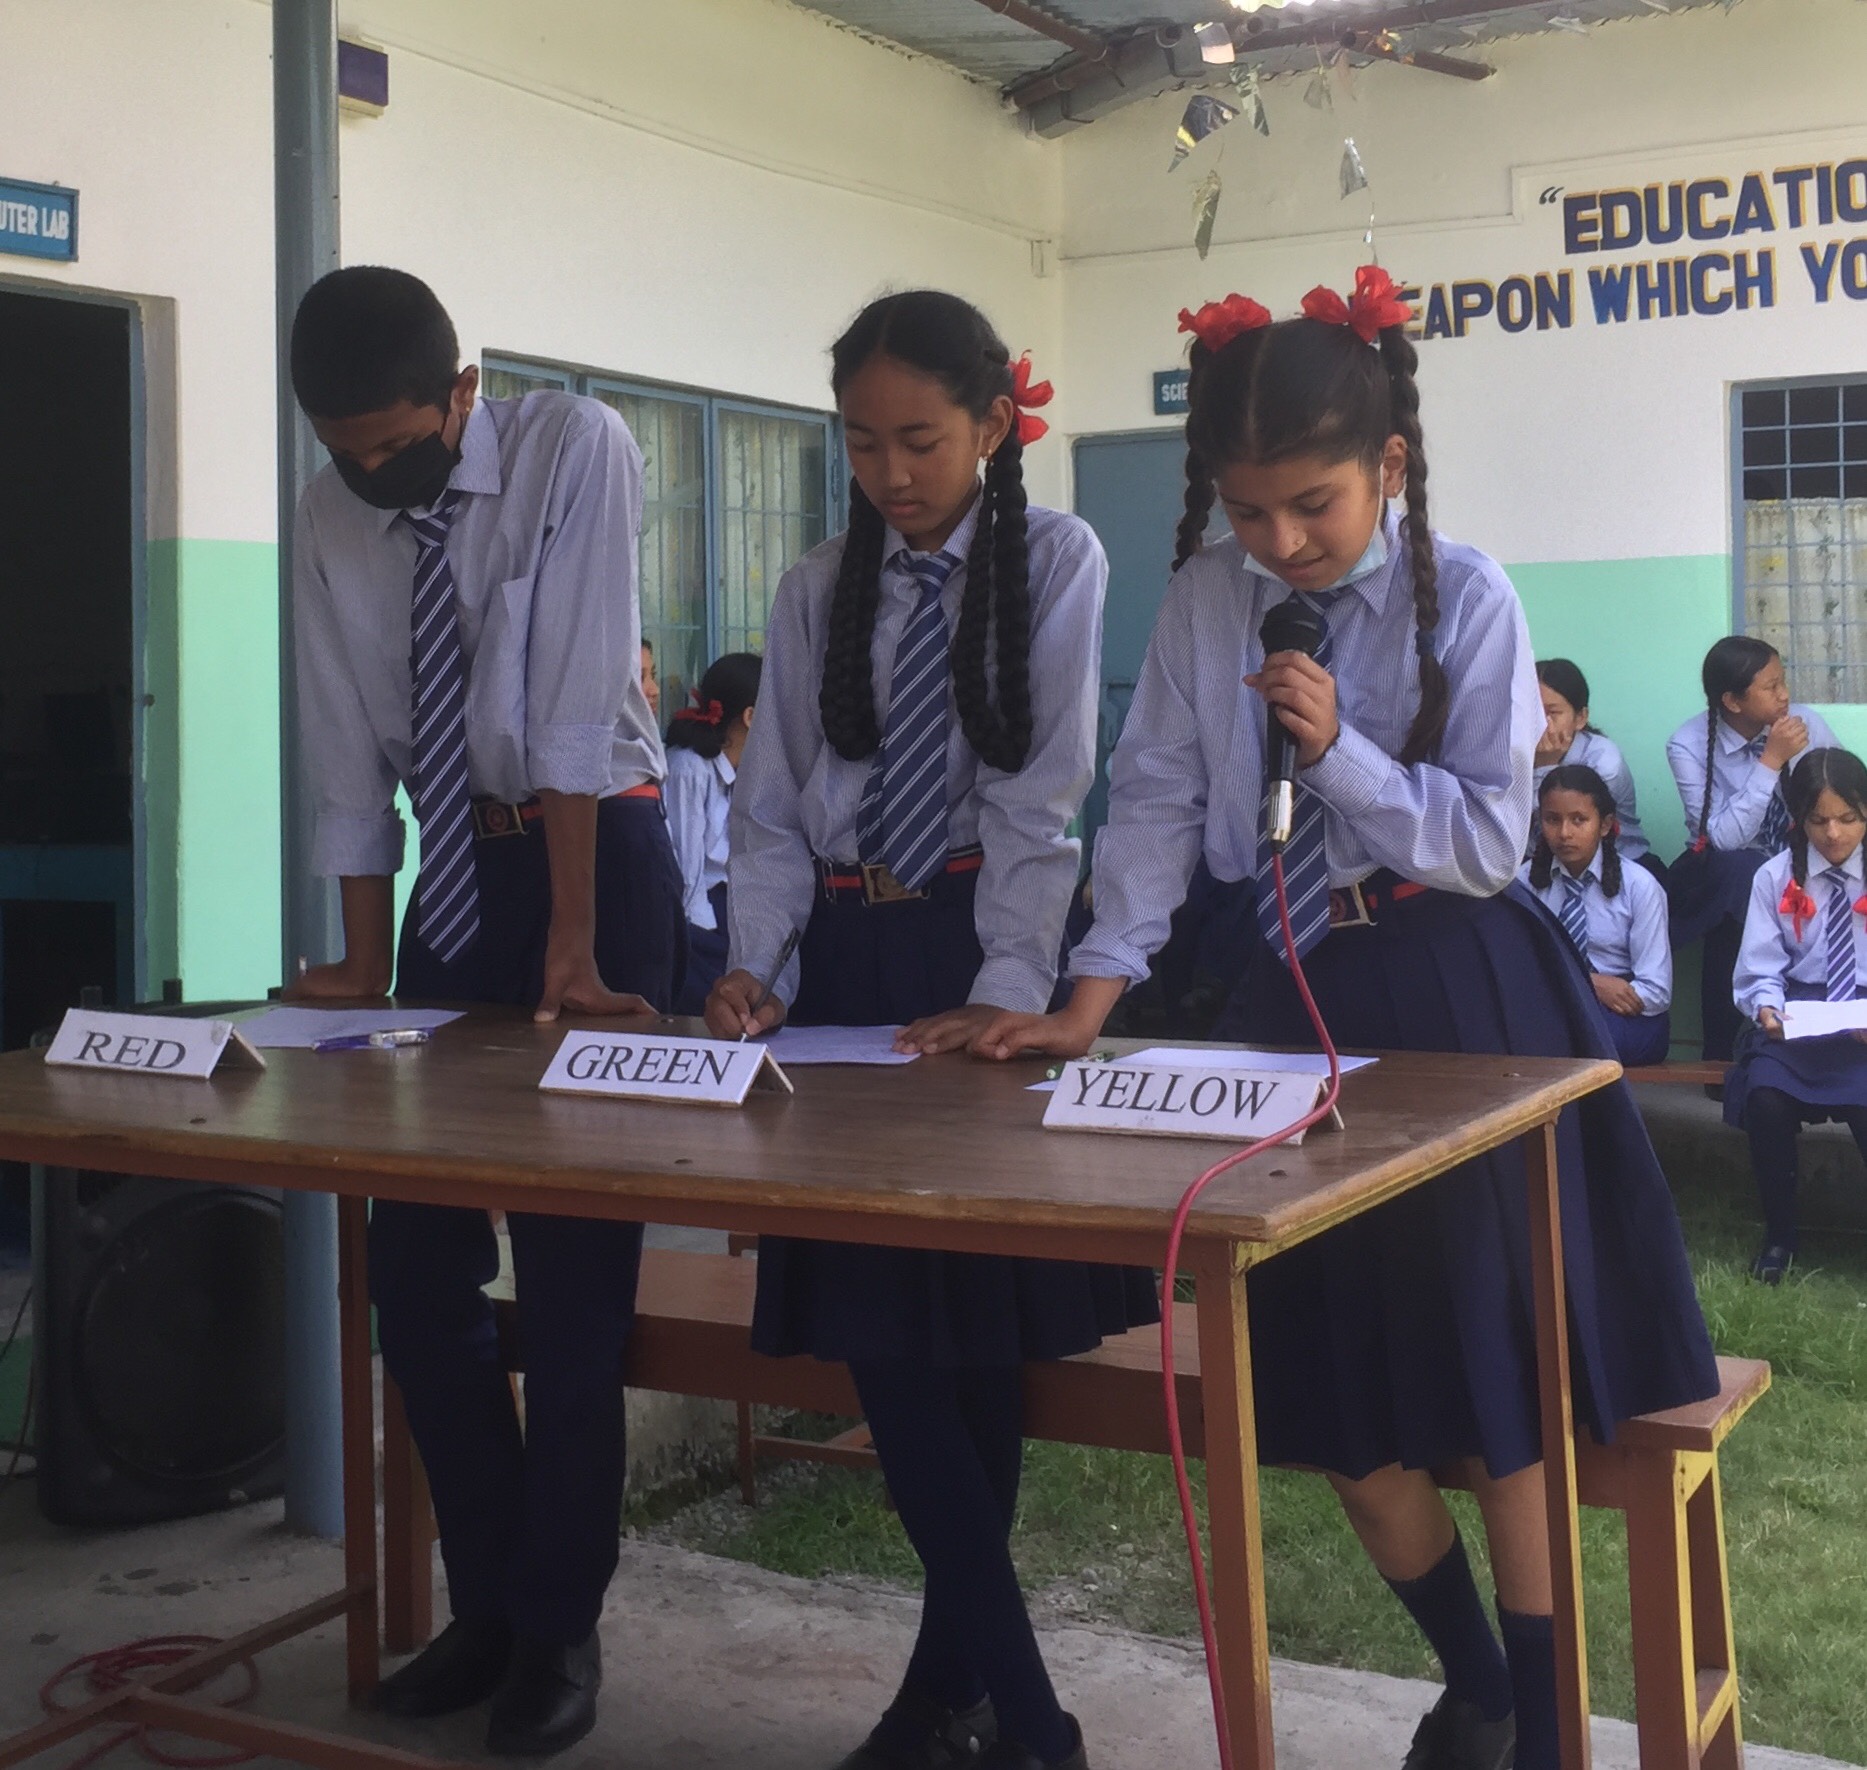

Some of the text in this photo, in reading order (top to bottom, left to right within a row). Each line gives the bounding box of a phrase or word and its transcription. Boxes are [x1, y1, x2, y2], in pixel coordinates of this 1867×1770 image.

[42, 206, 70, 241] LAB
[1347, 235, 1867, 344] EAPON WHICH YO
[73, 1031, 186, 1070] RED
[566, 1044, 739, 1085] GREEN
[1072, 1067, 1280, 1121] YELLOW
